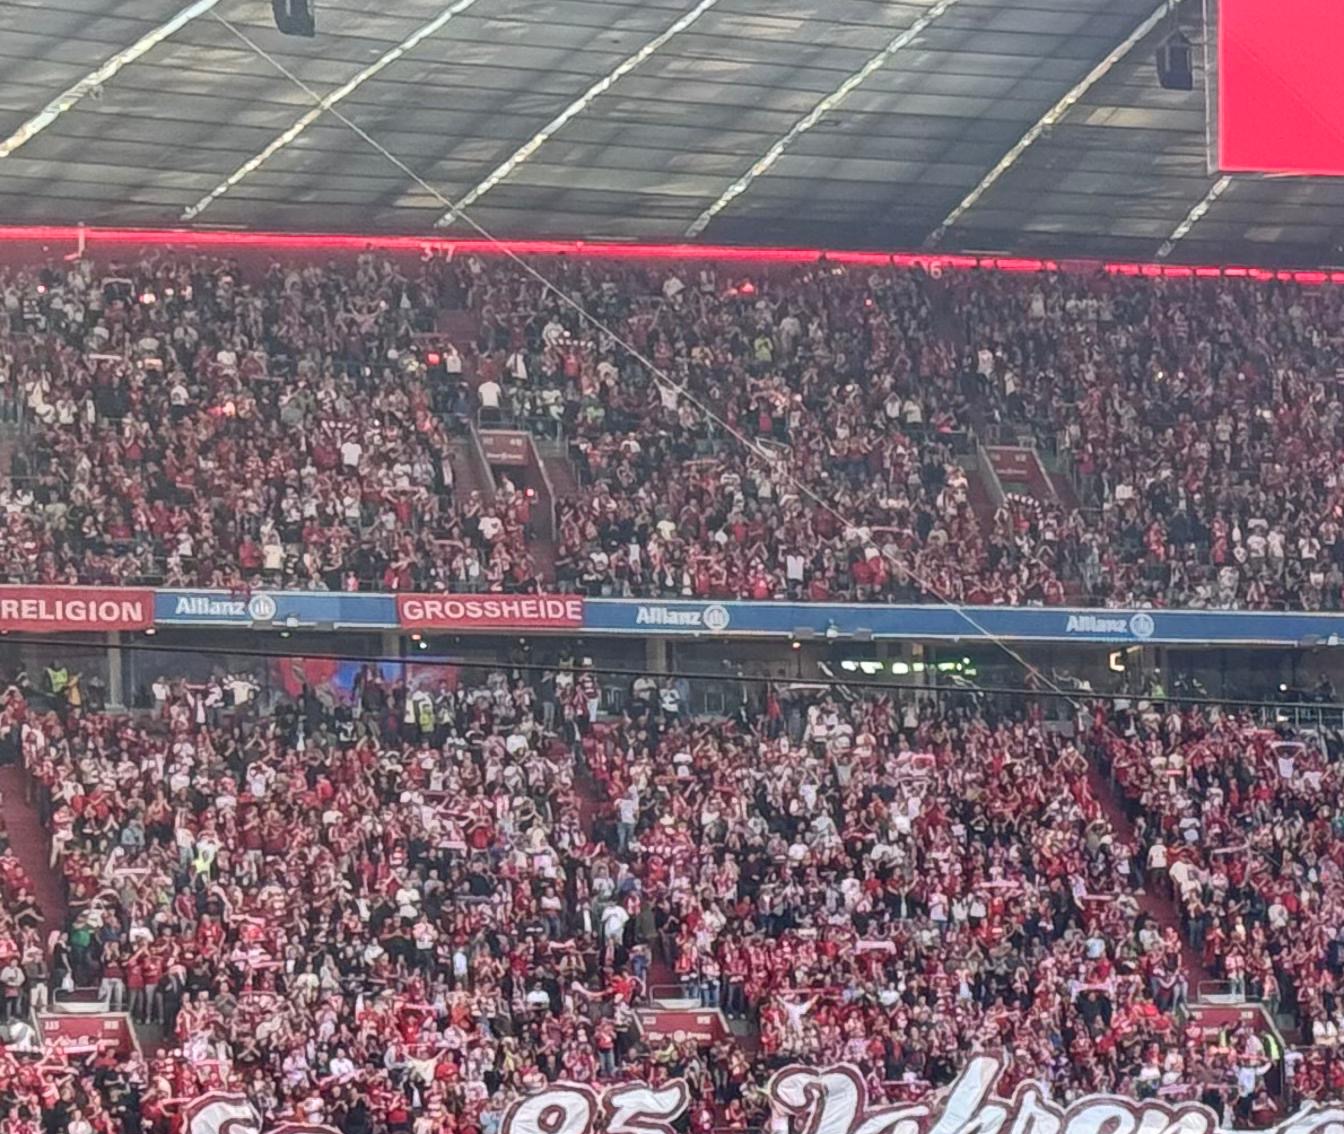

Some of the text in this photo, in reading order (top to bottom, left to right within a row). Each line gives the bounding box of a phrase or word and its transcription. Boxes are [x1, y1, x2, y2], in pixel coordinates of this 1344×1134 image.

[1, 599, 143, 622] RELIGION
[176, 596, 246, 616] Allianz
[403, 600, 583, 621] GROSSHEIDE
[636, 605, 702, 625] Allianz
[1066, 615, 1128, 633] Allianz
